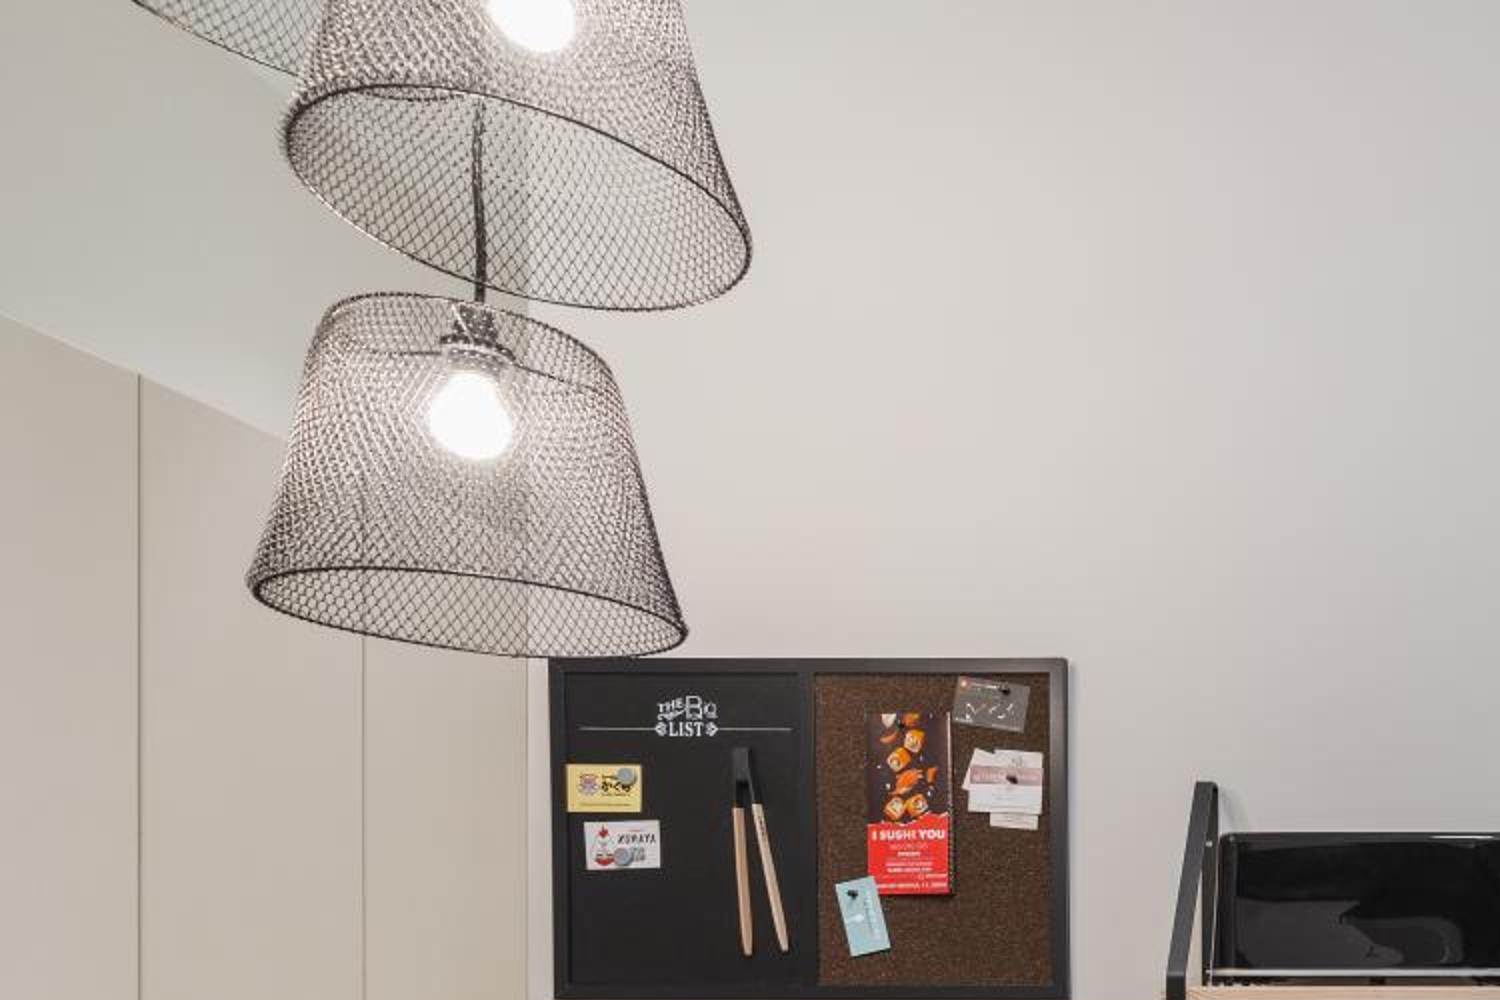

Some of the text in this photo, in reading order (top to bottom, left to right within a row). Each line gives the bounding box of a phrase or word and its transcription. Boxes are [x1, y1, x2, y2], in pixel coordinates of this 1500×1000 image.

[657, 697, 683, 713] THE
[668, 721, 704, 737] LIST
[871, 829, 945, 841] I SUSHI YOU
